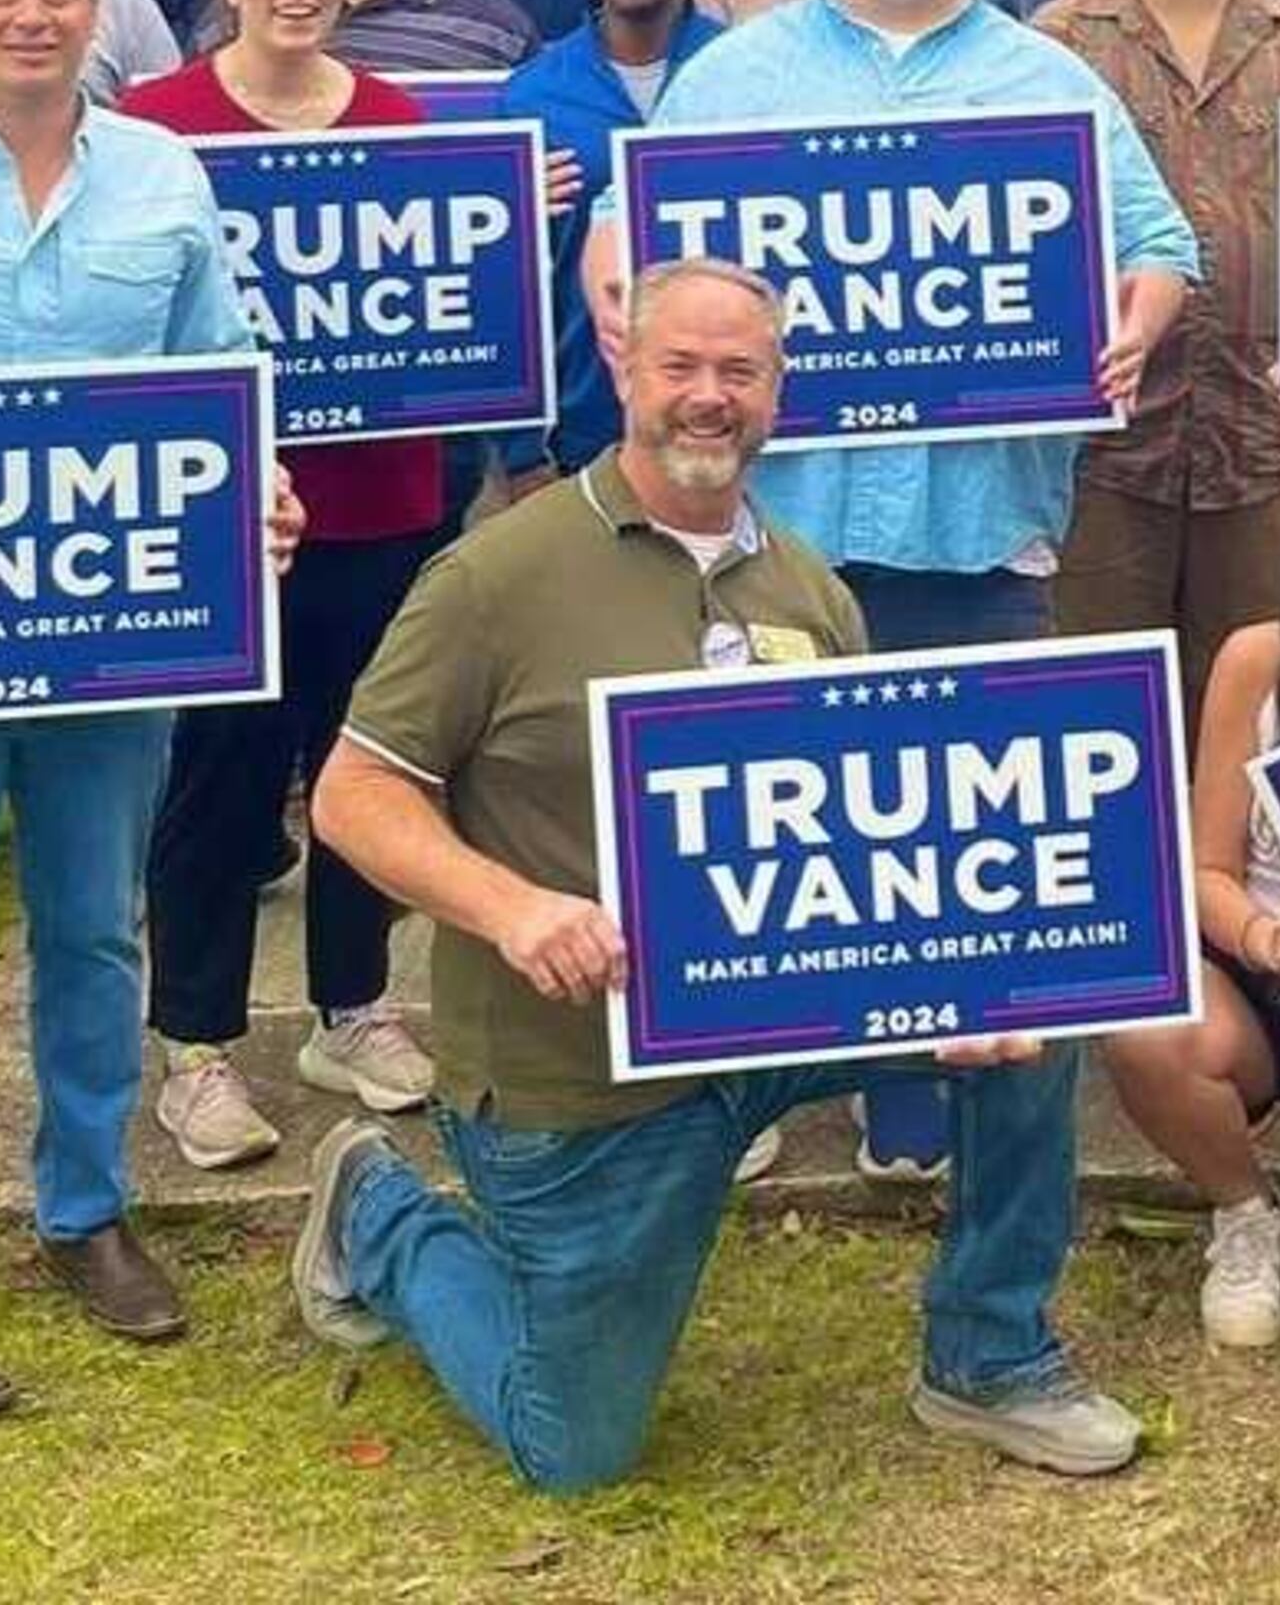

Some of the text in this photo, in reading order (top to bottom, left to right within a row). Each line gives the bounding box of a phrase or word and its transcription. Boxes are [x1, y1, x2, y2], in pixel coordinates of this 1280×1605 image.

[218, 194, 511, 278] RUMP
[658, 179, 1072, 269] TRUMP
[239, 273, 474, 343] ANCE
[783, 263, 1034, 337] ANCE
[333, 352, 407, 372] GREAT
[415, 345, 499, 366] AGAIN!
[782, 339, 1060, 372] MERICA GREAT AGAIN!
[287, 406, 363, 430] 2024
[838, 402, 919, 428] 2024
[18, 614, 104, 637] GREAT
[116, 607, 210, 631] AGAIN!
[646, 729, 1139, 856] TRUMP
[707, 832, 1094, 936] VANCE
[684, 921, 1128, 984] MAKE AMERICA GREAT AGAIN!
[866, 1004, 959, 1037] 2024
